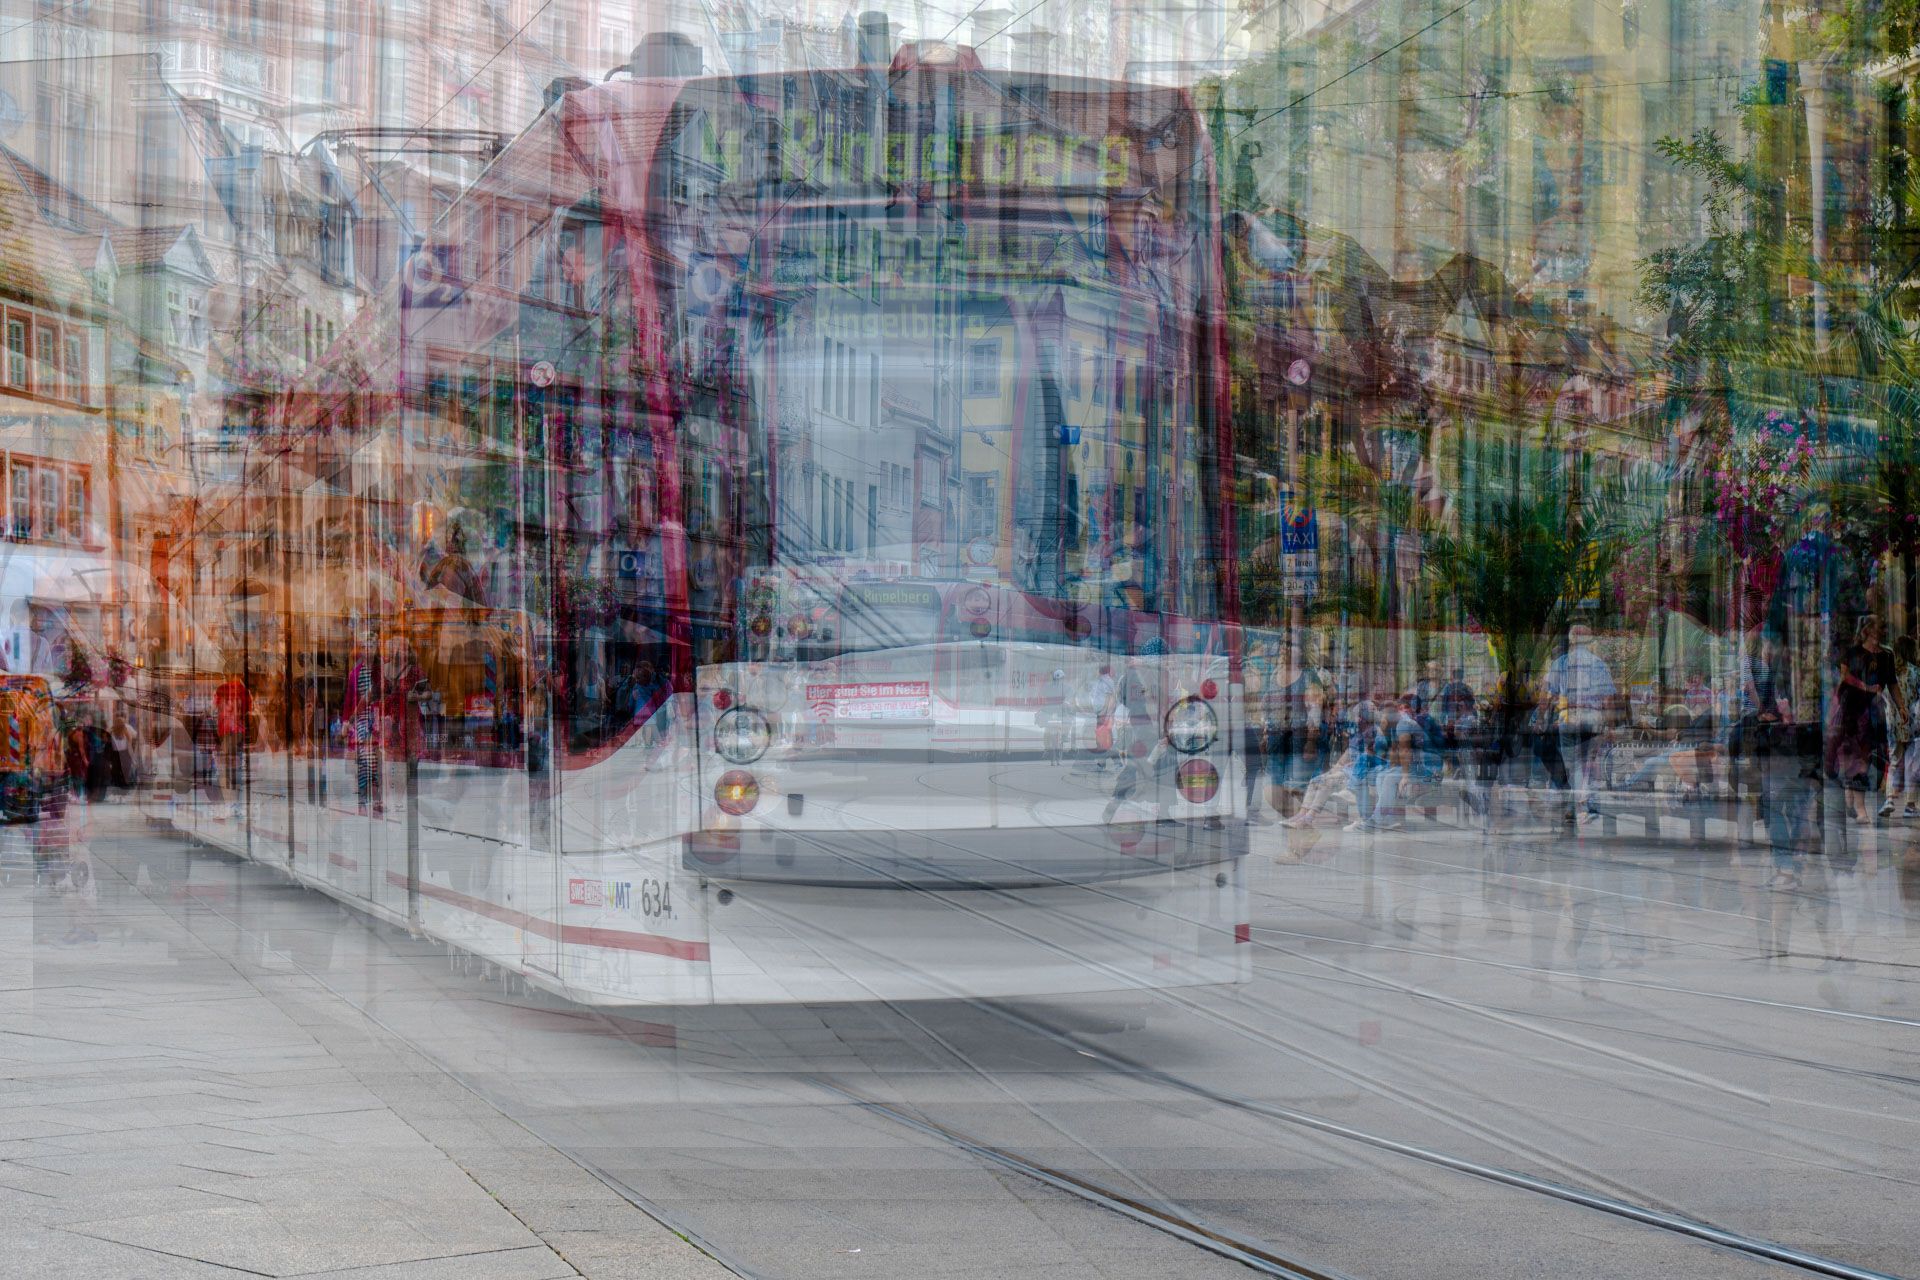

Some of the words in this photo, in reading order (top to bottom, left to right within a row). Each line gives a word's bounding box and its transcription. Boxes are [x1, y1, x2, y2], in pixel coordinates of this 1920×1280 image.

[1286, 532, 1315, 545] TAXI
[808, 685, 832, 699] Hier
[860, 683, 878, 696] Sie
[880, 682, 894, 695] im
[607, 881, 631, 909] VMT
